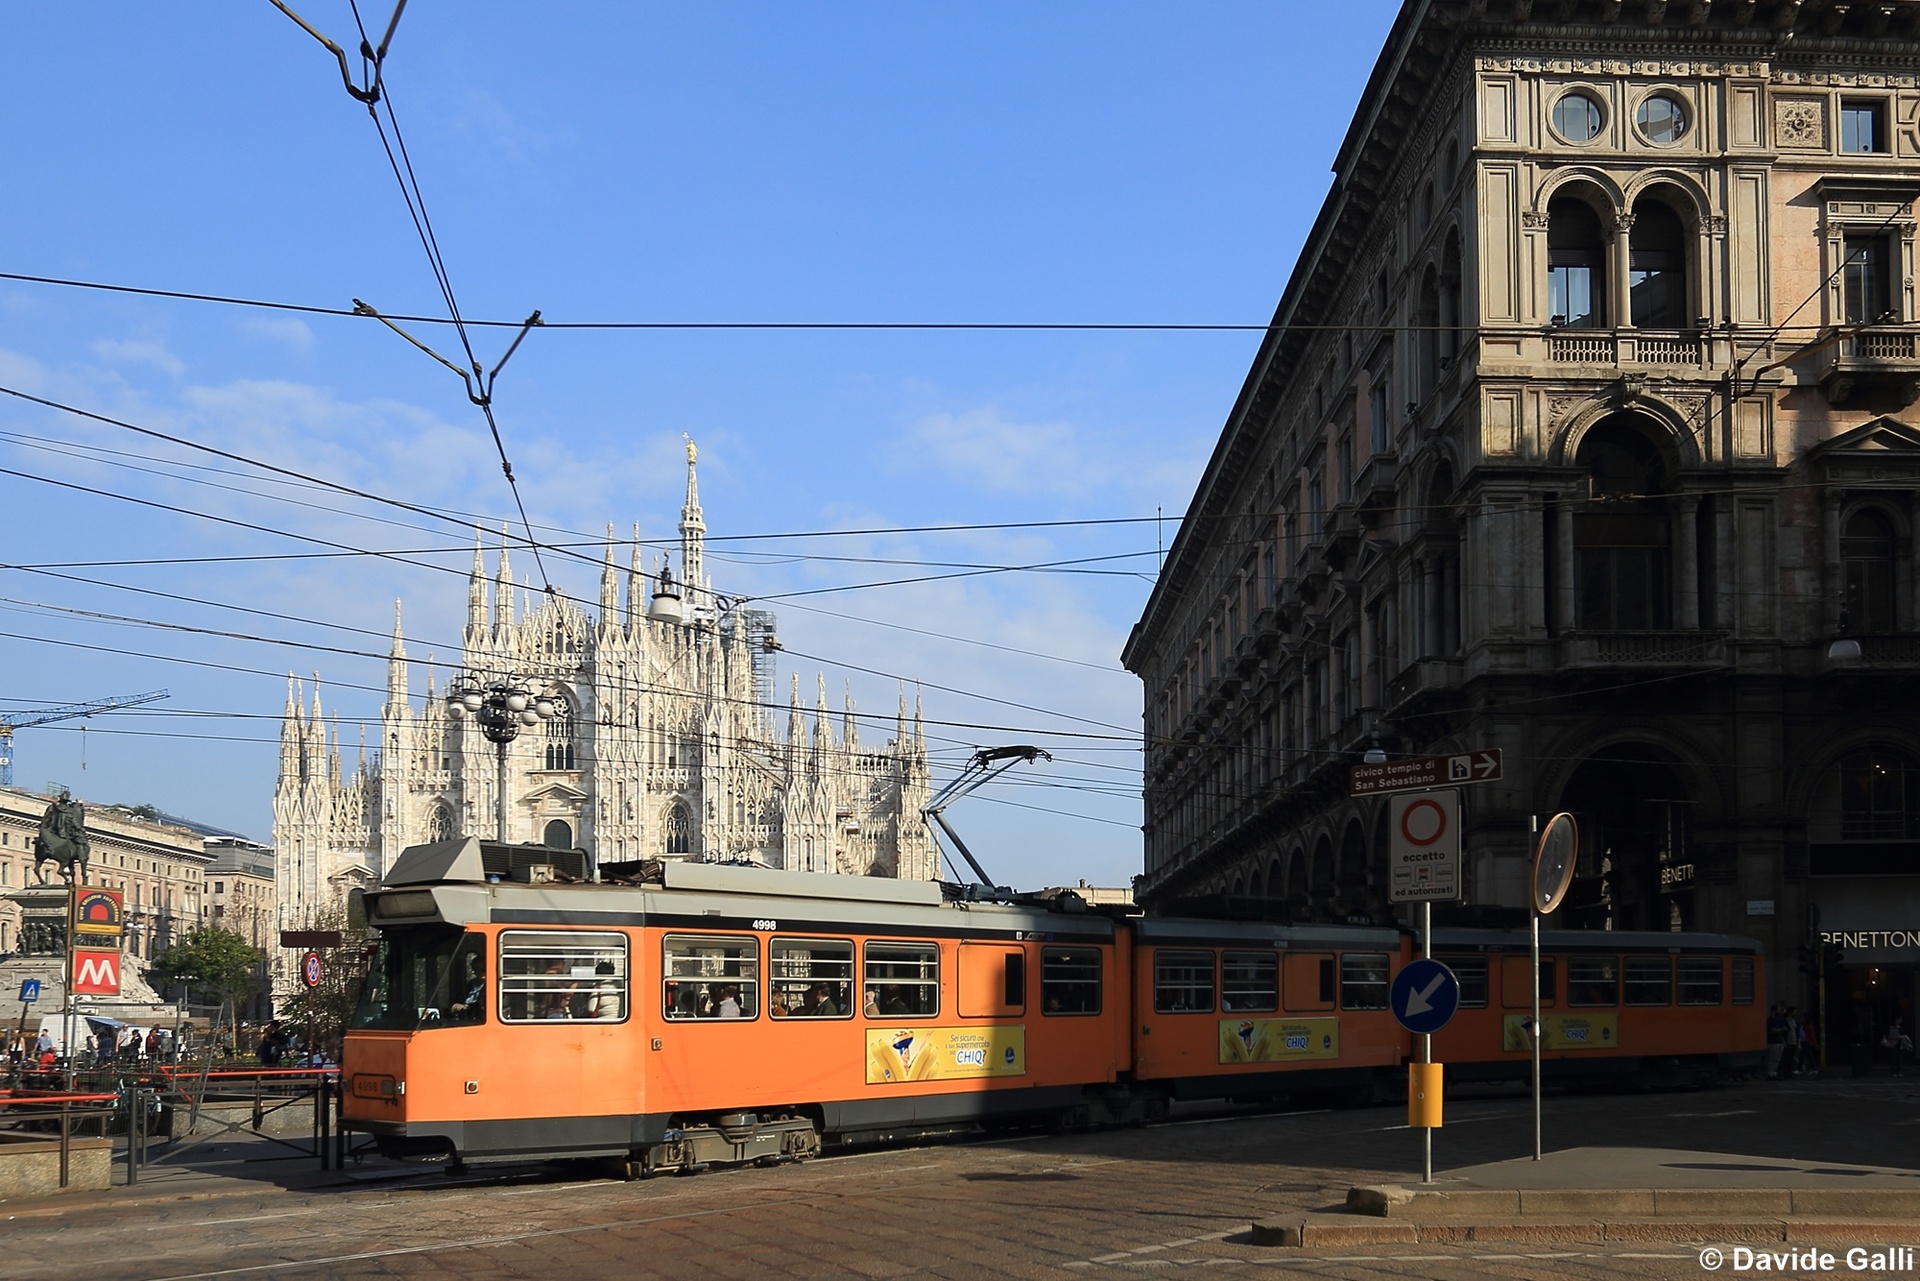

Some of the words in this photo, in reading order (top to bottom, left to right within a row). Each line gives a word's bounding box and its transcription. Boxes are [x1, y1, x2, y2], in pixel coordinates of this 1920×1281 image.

[1355, 767, 1383, 778] civico
[1387, 763, 1421, 774] tempio
[1425, 760, 1435, 769] di
[1355, 781, 1374, 790] San
[1378, 774, 1435, 788] Sebastiano
[1403, 851, 1445, 862] eccetto
[1395, 887, 1406, 897] ed
[1408, 885, 1453, 896] autorizzati
[752, 919, 777, 931] 4998
[1820, 930, 1920, 949] BENETTON
[77, 958, 117, 986] M
[957, 1049, 987, 1064] CHIQ?
